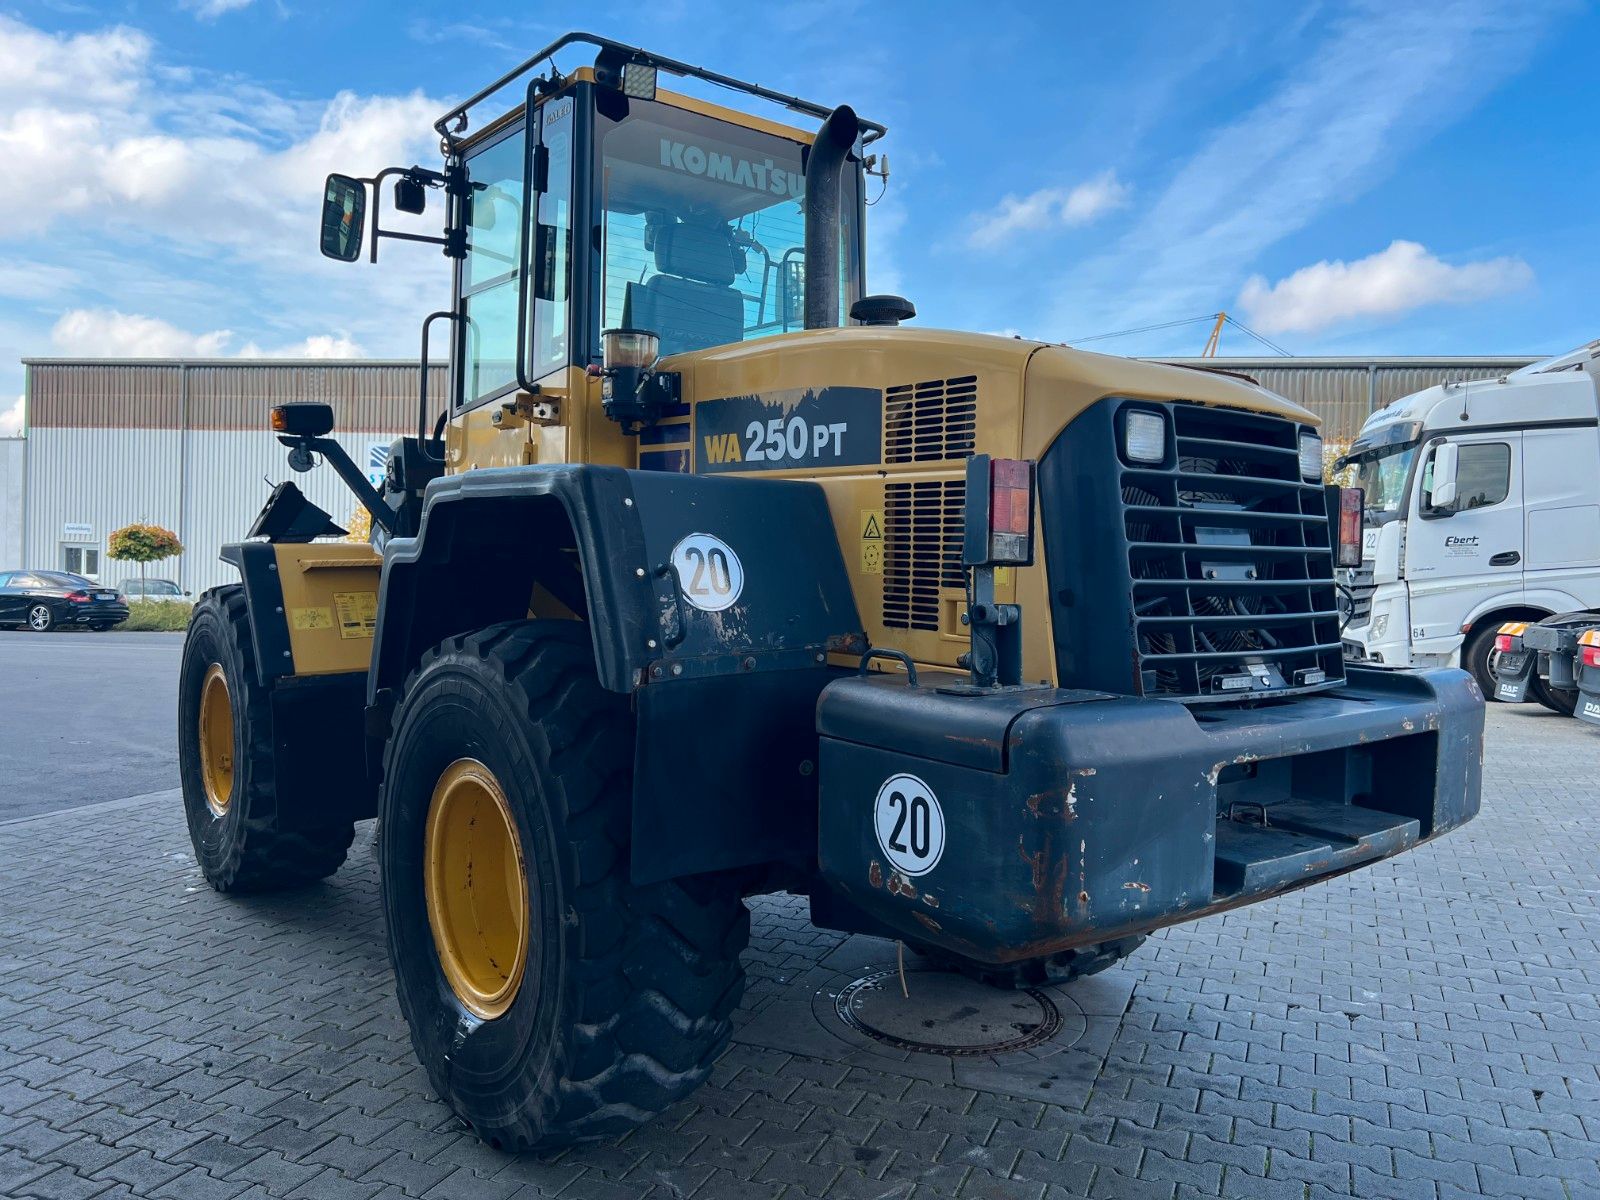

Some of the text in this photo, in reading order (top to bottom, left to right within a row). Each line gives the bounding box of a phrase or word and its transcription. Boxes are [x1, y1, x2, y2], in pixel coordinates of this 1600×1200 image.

[660, 138, 806, 198] KOMATSU
[704, 416, 847, 464] WA 250 PT
[1445, 536, 1479, 546] Ebert
[685, 546, 731, 595] 20
[1413, 628, 1425, 637] 64
[1501, 683, 1518, 693] DAF
[889, 791, 930, 859] 20
